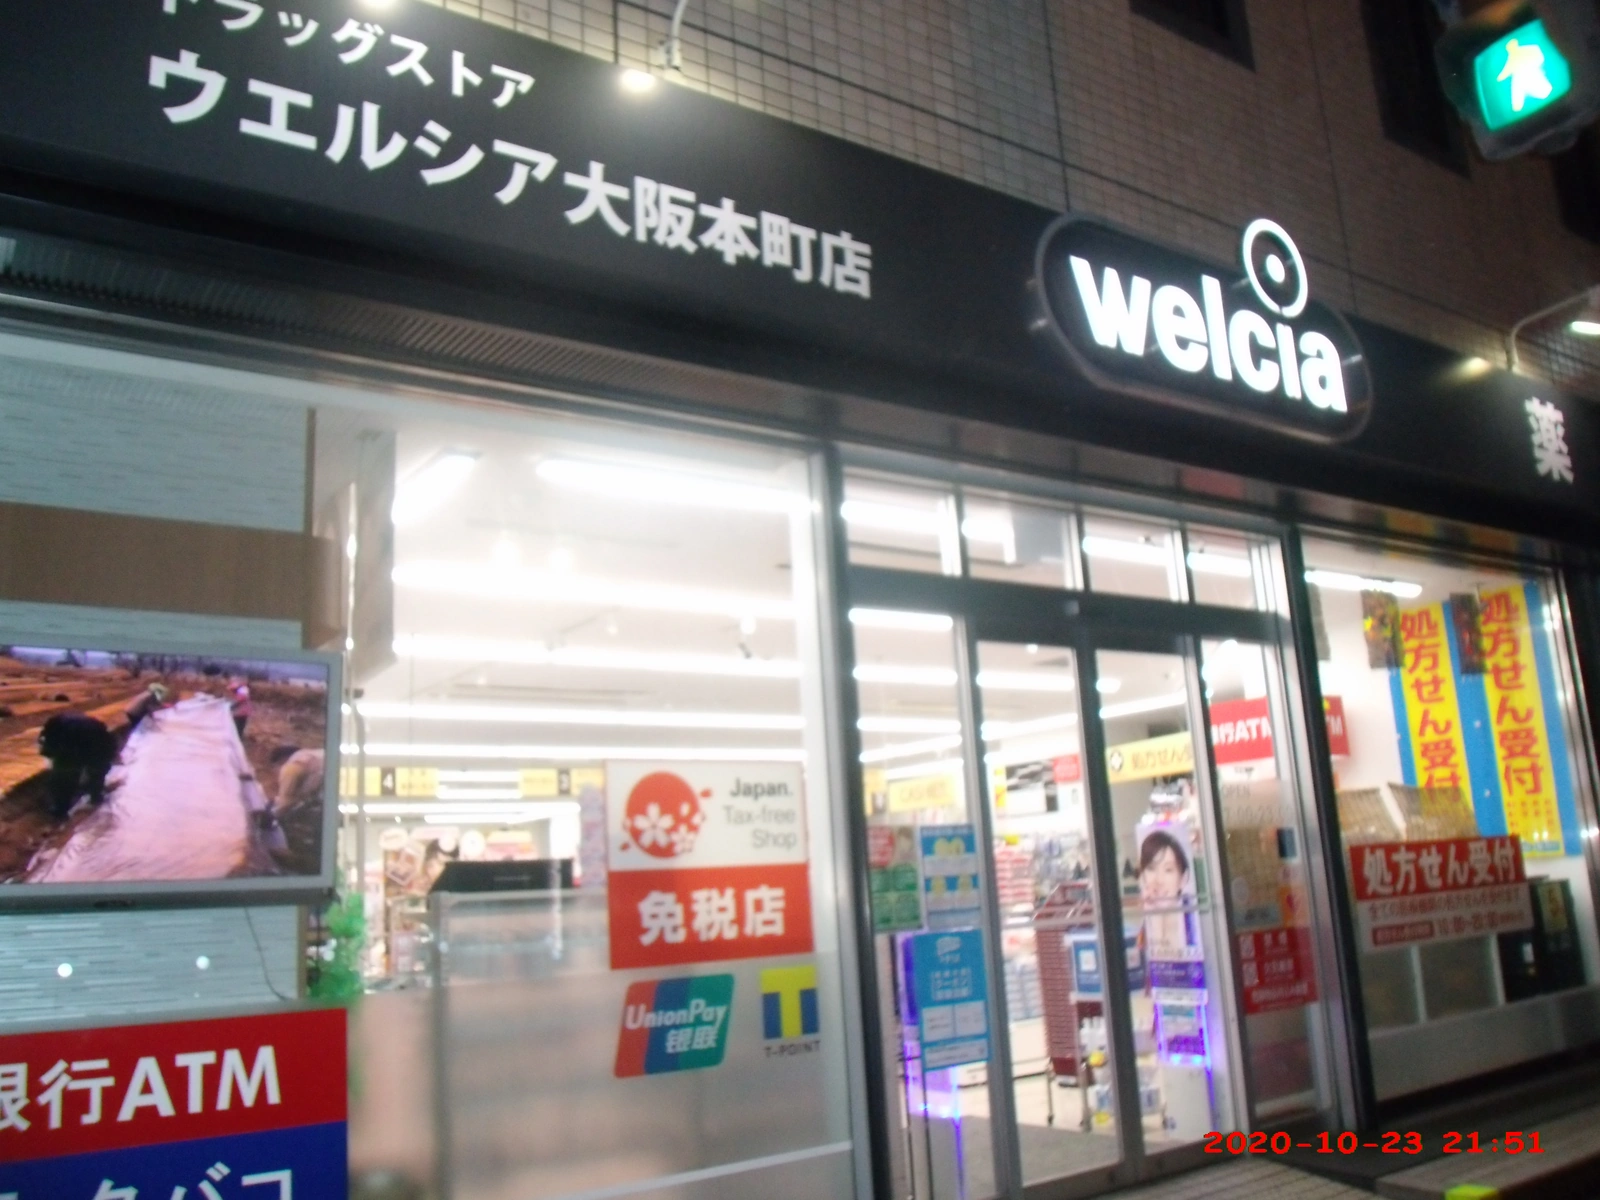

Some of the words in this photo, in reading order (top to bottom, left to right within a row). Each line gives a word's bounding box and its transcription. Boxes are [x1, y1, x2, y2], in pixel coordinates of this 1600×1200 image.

[163, 0, 535, 108] ラッグストア
[148, 49, 873, 298] ウエルシア大阪本町店
[1069, 219, 1347, 413] welcia
[1524, 397, 1574, 484] 薬
[1480, 591, 1543, 797] 処方せん受付
[723, 804, 796, 824] Tax-free
[752, 828, 797, 851] Shop
[1362, 836, 1517, 896] 処方せん受付
[637, 885, 786, 946] 免税店
[625, 998, 728, 1030] UnionPay
[764, 1040, 820, 1058] T-POINT
